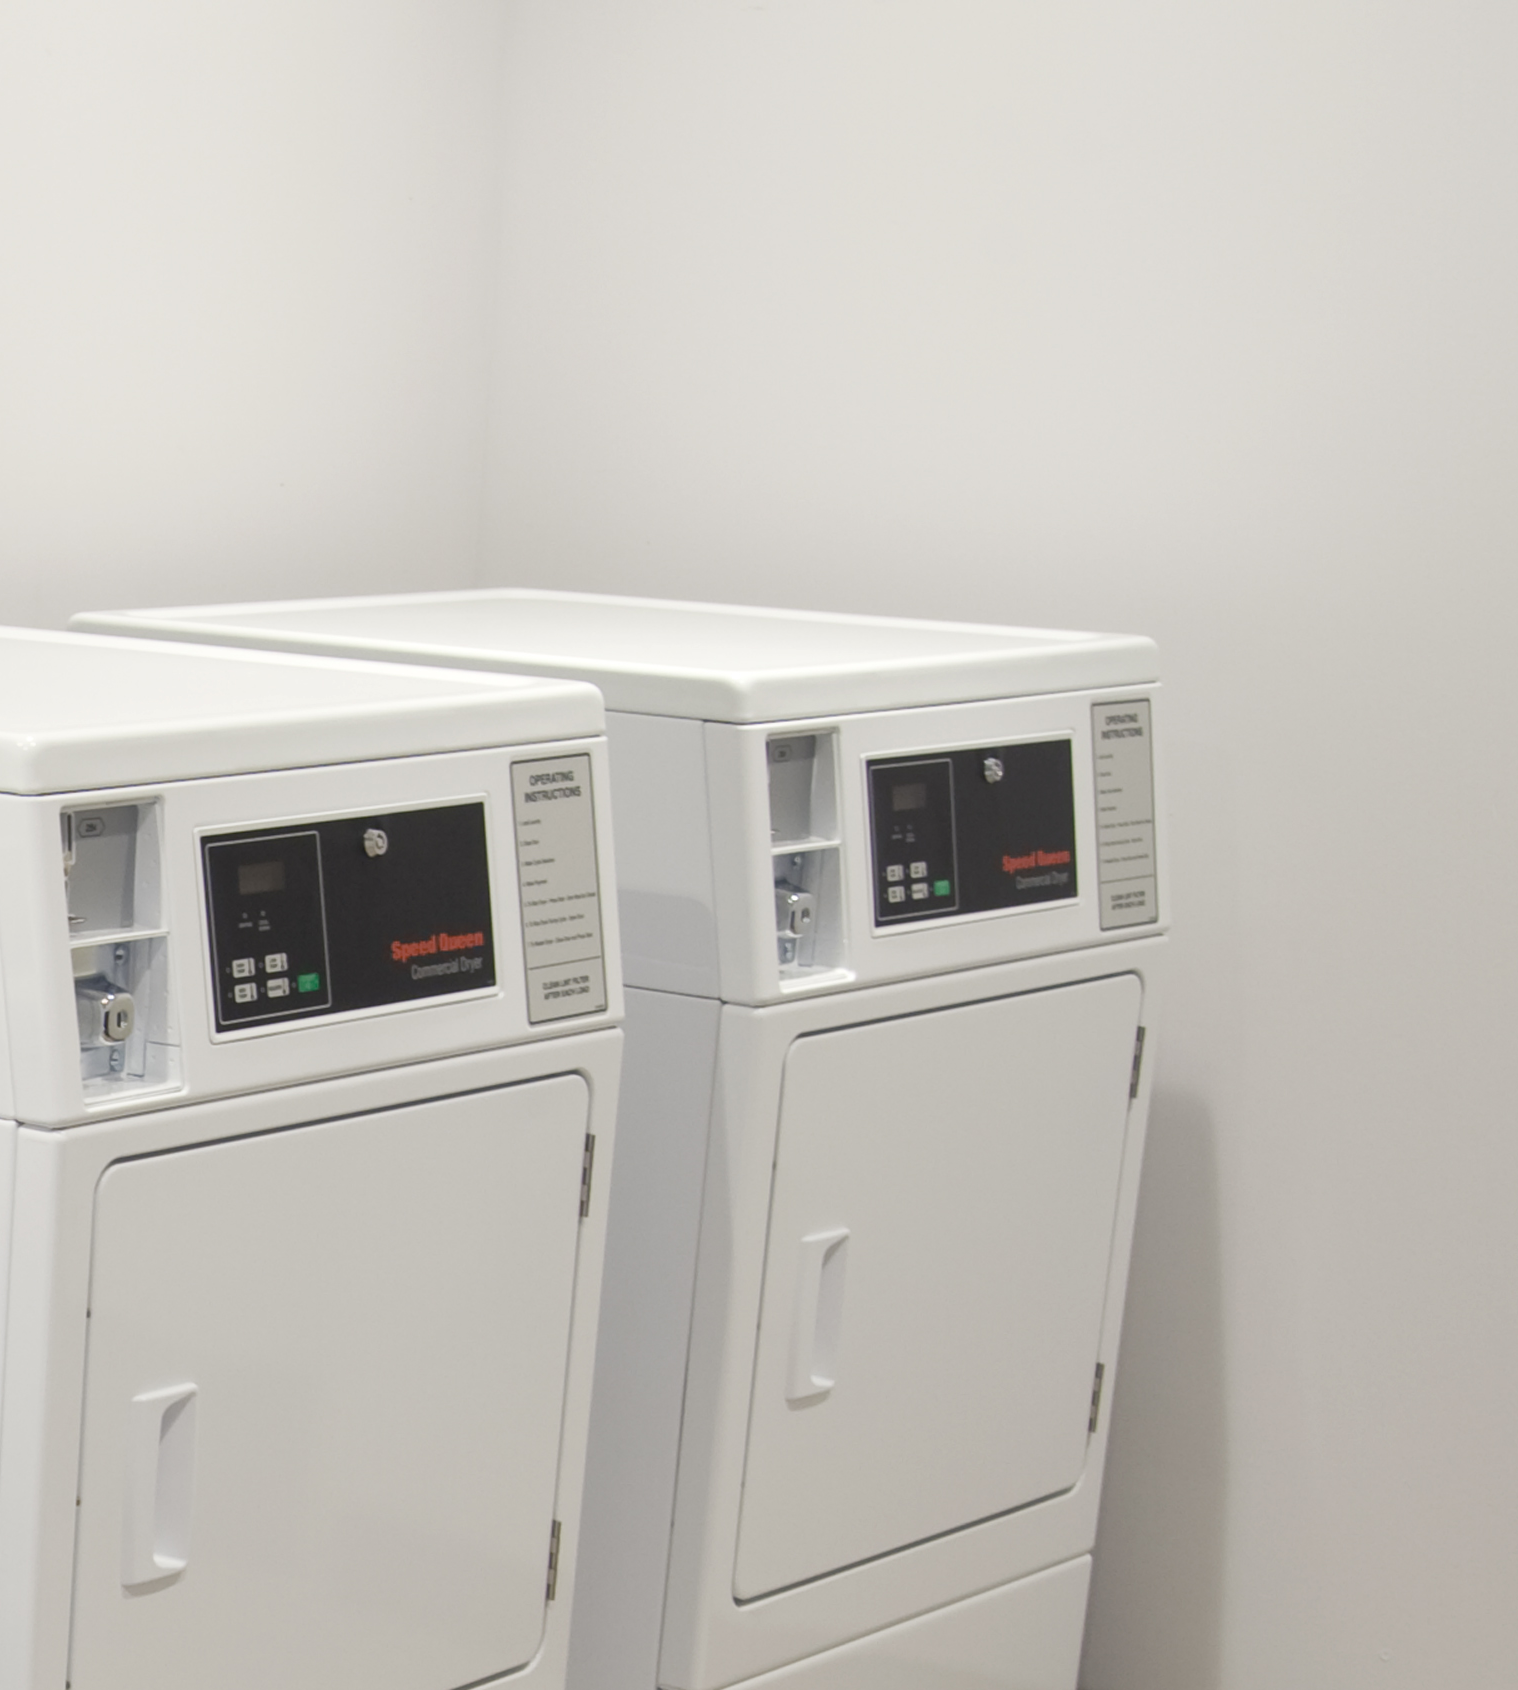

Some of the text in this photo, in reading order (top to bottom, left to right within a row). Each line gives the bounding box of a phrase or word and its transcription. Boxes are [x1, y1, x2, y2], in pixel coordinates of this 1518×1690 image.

[529, 770, 574, 786] OPERATING
[524, 786, 582, 803] INSTRUCTIONS
[391, 931, 484, 963] Speed Queen
